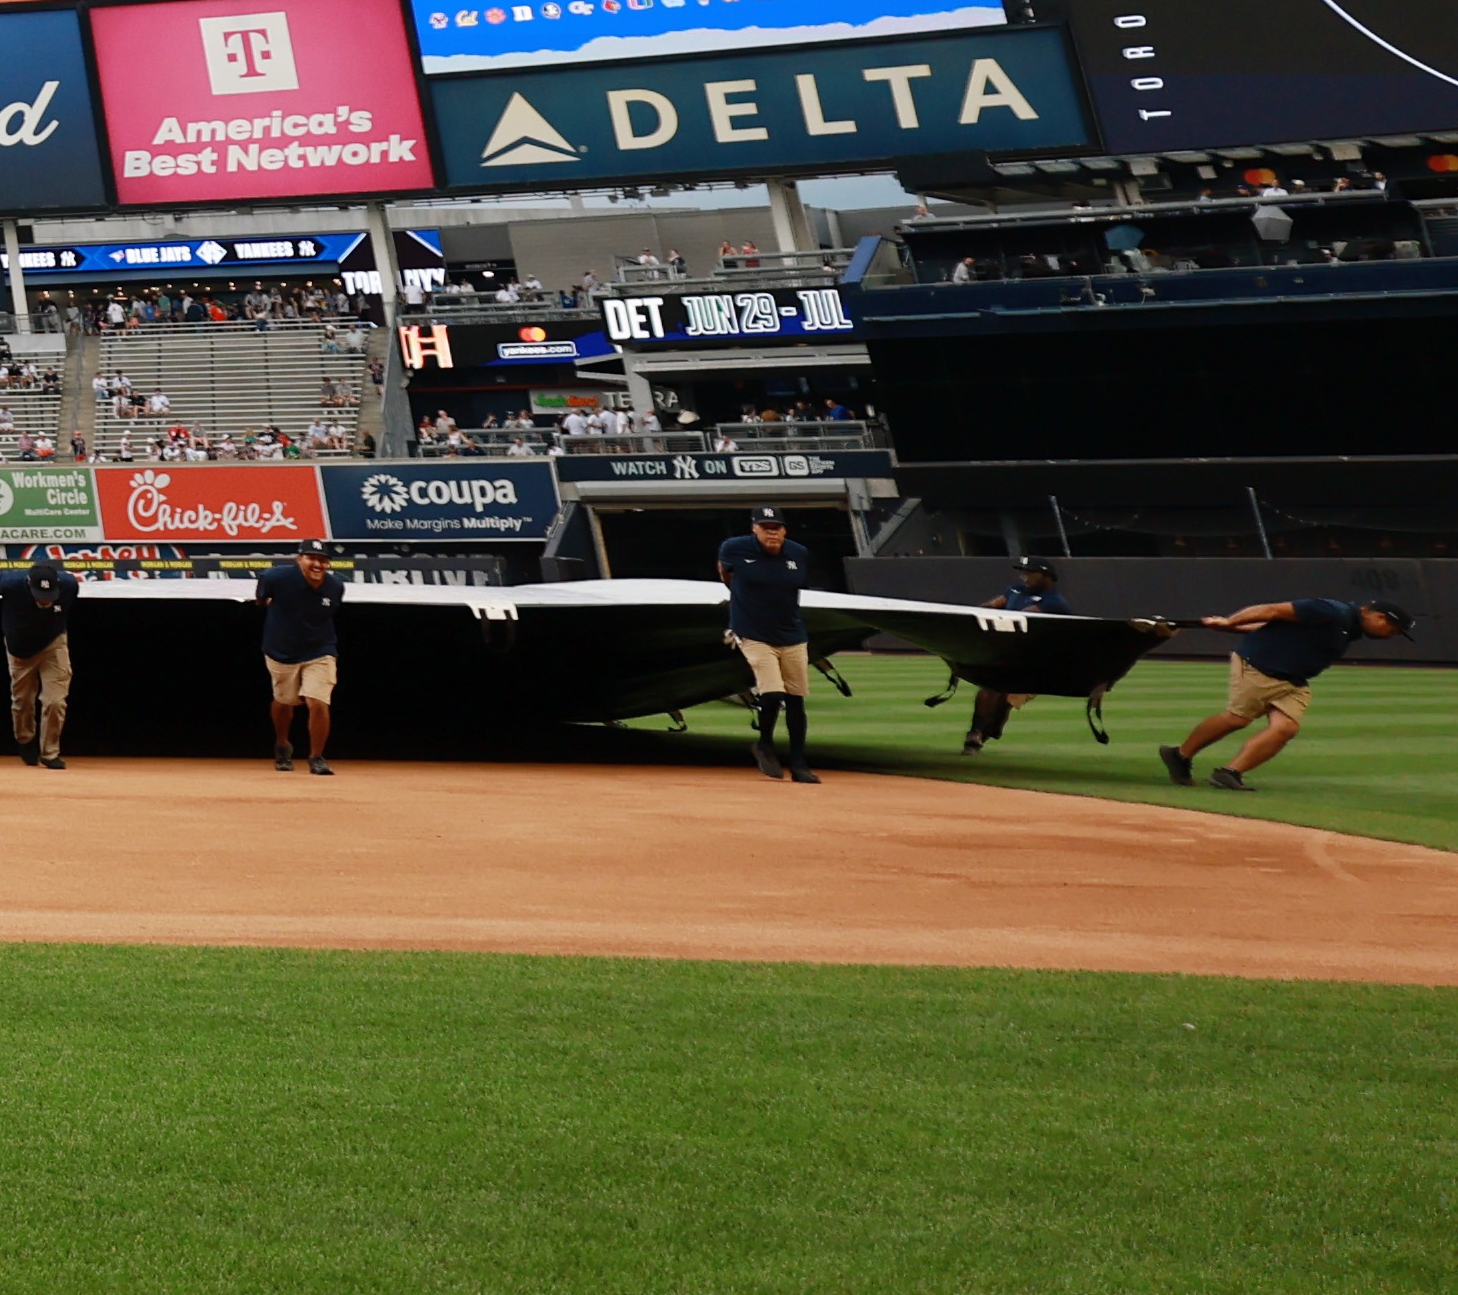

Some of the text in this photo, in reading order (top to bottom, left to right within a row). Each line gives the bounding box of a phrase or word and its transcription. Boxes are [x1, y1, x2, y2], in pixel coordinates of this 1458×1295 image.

[606, 58, 1039, 152] DELTA
[152, 107, 373, 146] America's
[123, 132, 417, 178] Best Network
[0, 252, 55, 268] YNKEES
[126, 242, 294, 264] BLUE JAYS YANKEES
[341, 270, 383, 295] TOR
[403, 268, 446, 292] NYY
[604, 288, 853, 340] DET JUN 29 JUL
[12, 472, 86, 488] Workmen's
[610, 461, 771, 476] WATCH ON YES
[47, 488, 88, 505] Circle
[410, 478, 518, 512] coupa
[25, 507, 90, 516] MultiCare Center
[128, 485, 297, 536] Chick-fil-A
[366, 516, 522, 533] Make Margins Multiply
